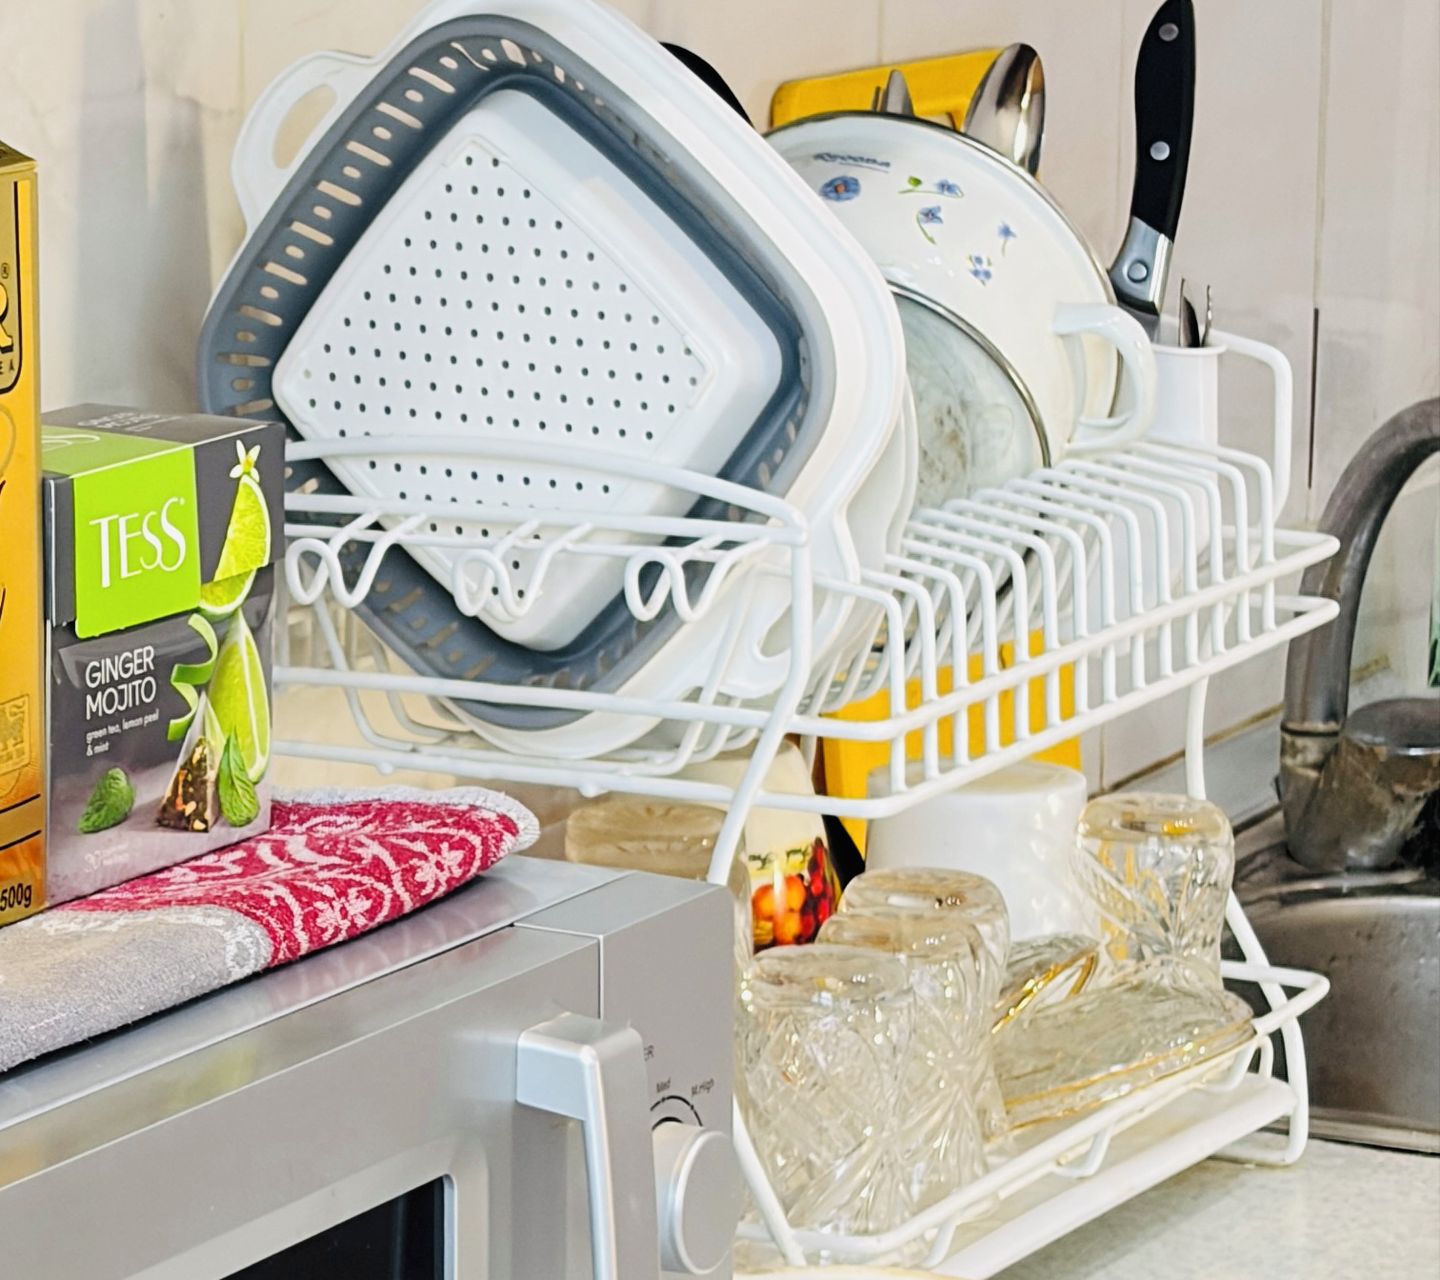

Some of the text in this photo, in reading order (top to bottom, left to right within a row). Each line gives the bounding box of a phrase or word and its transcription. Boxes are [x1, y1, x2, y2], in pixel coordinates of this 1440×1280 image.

[89, 497, 186, 588] TESS
[85, 645, 155, 688] GINGER
[85, 676, 157, 721] MOJITO
[0, 883, 33, 912] 500g
